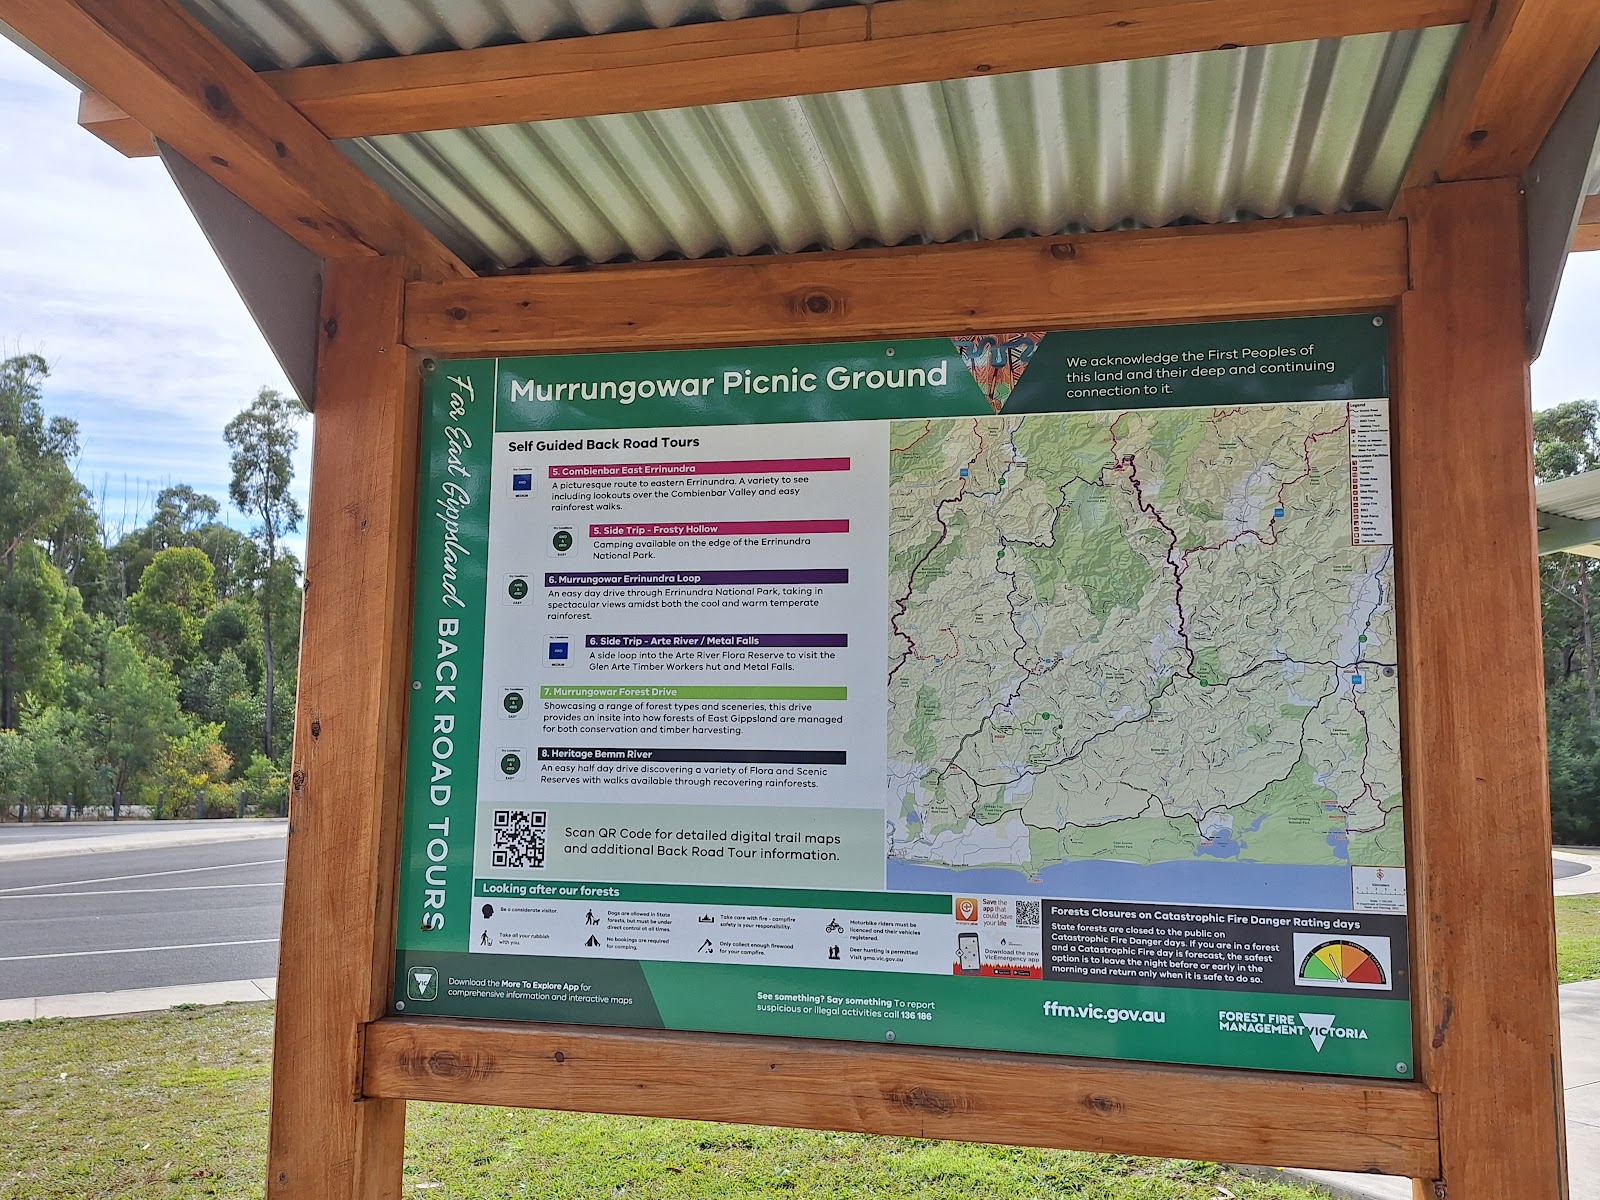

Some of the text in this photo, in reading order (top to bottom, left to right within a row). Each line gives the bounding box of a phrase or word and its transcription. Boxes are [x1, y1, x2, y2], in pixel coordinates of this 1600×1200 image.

[1066, 344, 1314, 368] We acknowledge the First Peoples of
[1066, 360, 1335, 383] this land and their deep and continuing
[511, 360, 947, 405] Murrungowar Picnic Ground
[1066, 383, 1173, 398] connection to it.
[508, 436, 700, 452] Self Guided Back Road Tours
[552, 464, 696, 476] 5. Combienbar East Errinundra
[593, 526, 602, 535] 5.
[603, 526, 624, 535] Side
[626, 525, 646, 536] Trip
[653, 525, 684, 535] Frosty
[686, 524, 718, 533] Hollow
[548, 574, 701, 585] 6. Murrungowar Errinundra Loop
[590, 637, 598, 646] 6.
[600, 636, 621, 646] Side
[622, 636, 643, 647] Trip
[650, 637, 672, 645] Arte
[673, 636, 699, 645] River
[700, 636, 706, 646] /
[706, 636, 734, 645] Metal
[736, 636, 760, 645] Falls
[423, 375, 475, 932] Far East Gippsland BACK ROAD TOURS
[589, 662, 795, 671] Glen Arte Timber Workers hut and Metal Falls.
[544, 687, 678, 698] 7. Murrungowar Forest Drive
[541, 748, 653, 760] 8. Heritage Bemm River
[565, 827, 841, 846] Scan QR Code for detailed digital trail maps
[564, 843, 840, 861] and additional Back Road Tour information.
[482, 882, 620, 897] Looking after our forests
[1051, 906, 1090, 917] Forests
[1091, 908, 1137, 919] Closures
[1154, 911, 1225, 924] Catastrophic
[1227, 914, 1249, 924] Fire
[1250, 915, 1292, 927] Danger
[1293, 917, 1330, 930] Rating
[1332, 919, 1360, 930] days
[1051, 922, 1076, 931] State
[1076, 923, 1108, 933] forests
[1125, 926, 1154, 935] closed
[1155, 928, 1166, 936] to
[1167, 928, 1183, 936] the
[1184, 929, 1212, 938] public
[984, 954, 1027, 963] VicEmergency
[448, 977, 592, 992] Download the More To Explore App for
[447, 989, 633, 1005] comprehensive information and interactive maps
[757, 991, 936, 1010] See something? Say something To report
[757, 1003, 802, 1013] suspicious
[814, 1005, 840, 1016] illegal
[841, 1008, 882, 1018] activities
[883, 1010, 900, 1019] call
[900, 1011, 916, 1020] 136
[916, 1012, 932, 1021] 186
[1042, 1000, 1166, 1024] ffm.vic.gov.au
[1219, 1011, 1296, 1025] FOREST FIRE
[1219, 1022, 1368, 1040] MANAGEMENT VICTORIA
